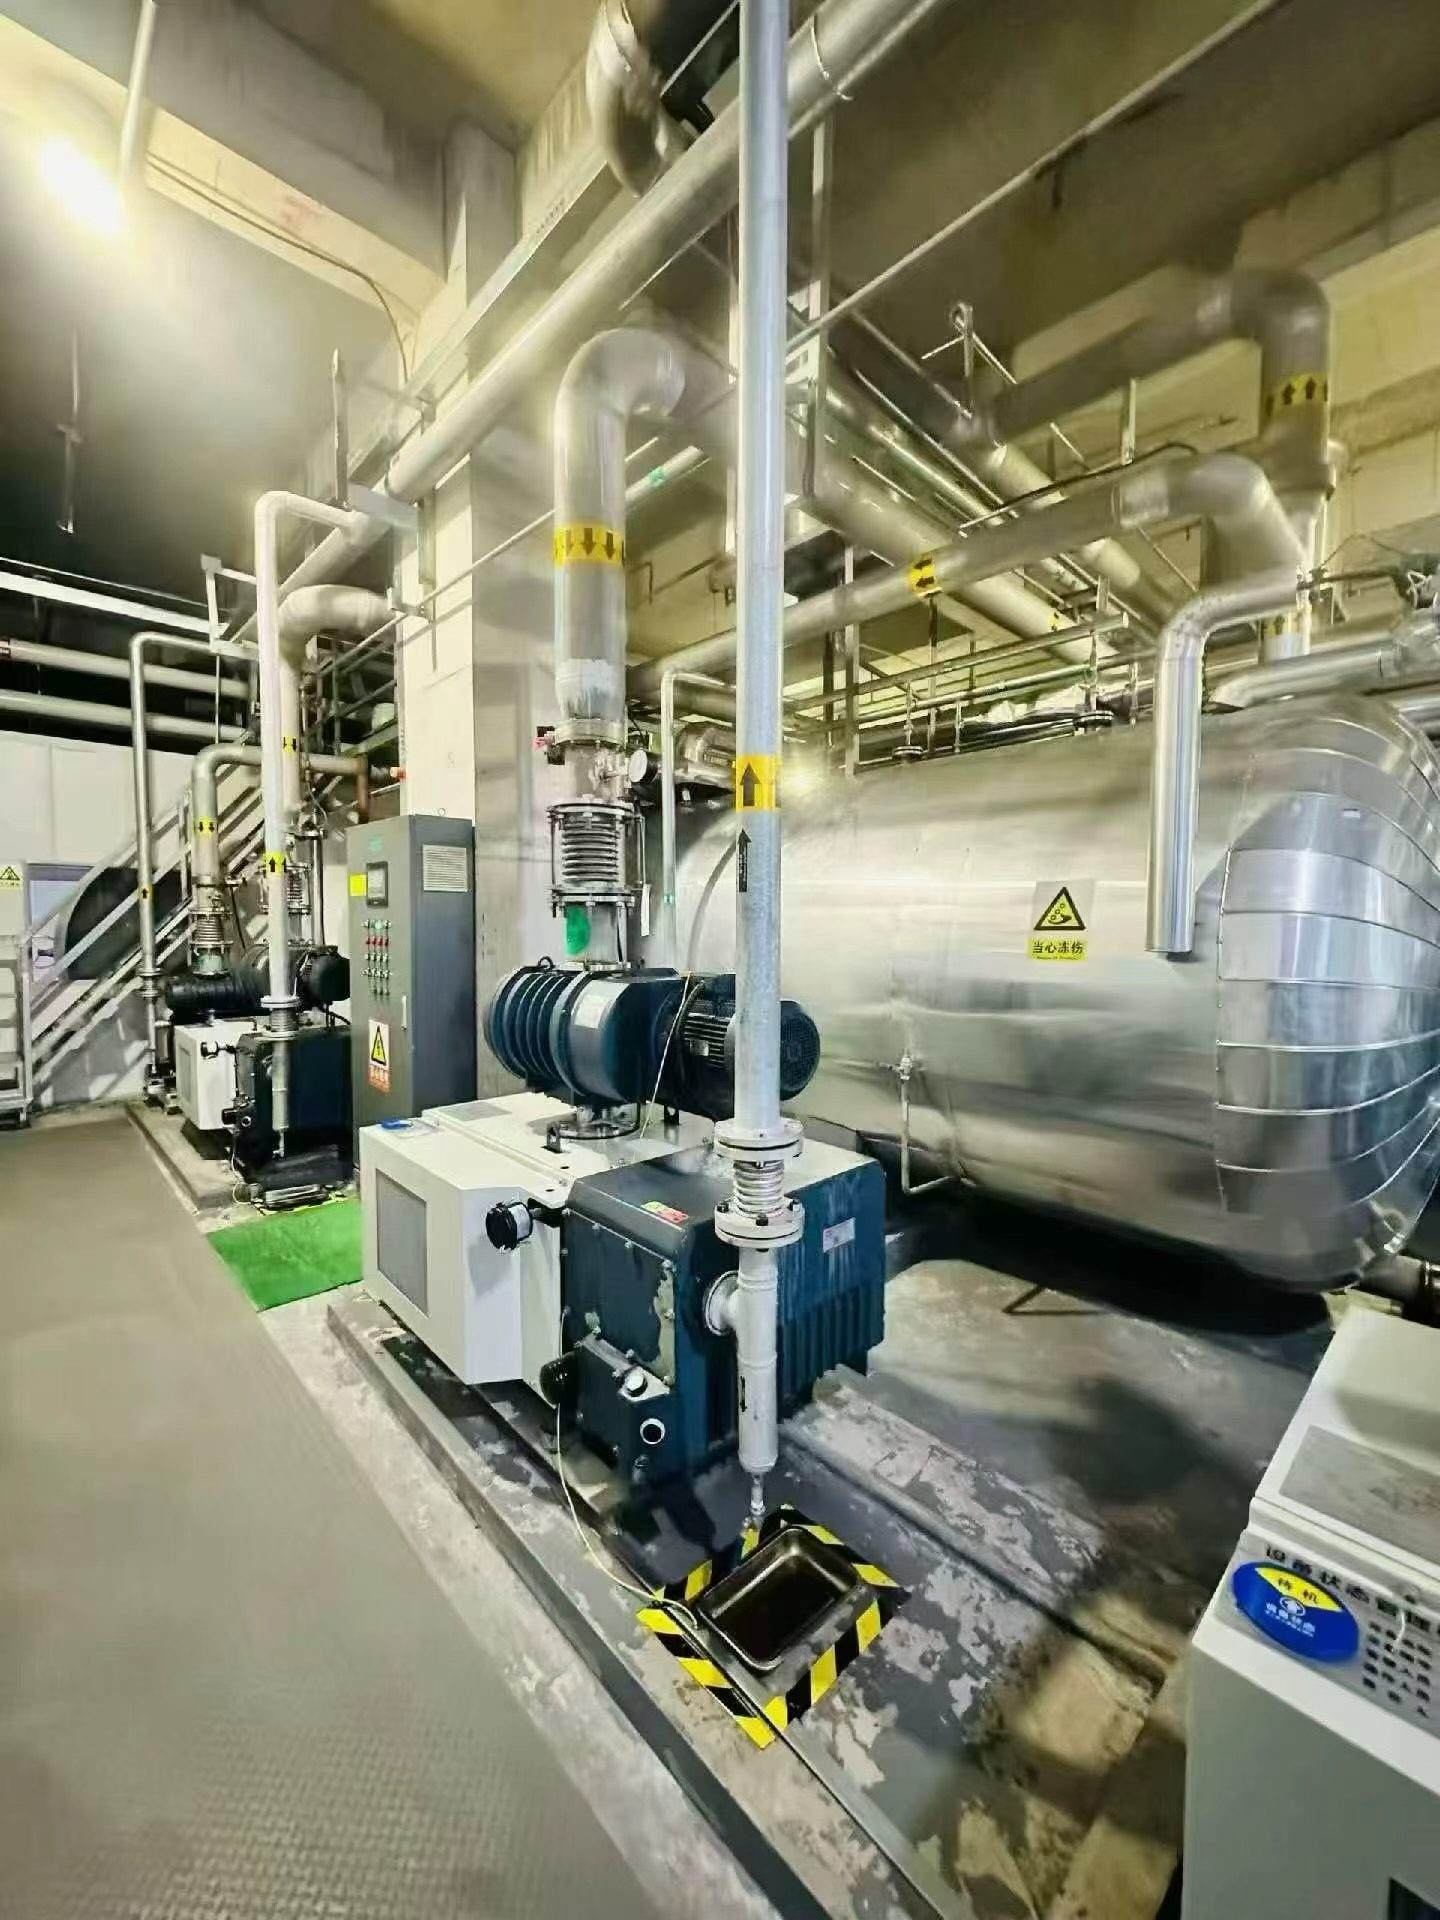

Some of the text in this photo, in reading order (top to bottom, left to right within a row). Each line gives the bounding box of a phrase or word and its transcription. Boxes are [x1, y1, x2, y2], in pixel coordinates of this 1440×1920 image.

[1032, 940, 1083, 954] 当心冻伤
[1277, 1577, 1319, 1604] 待机
